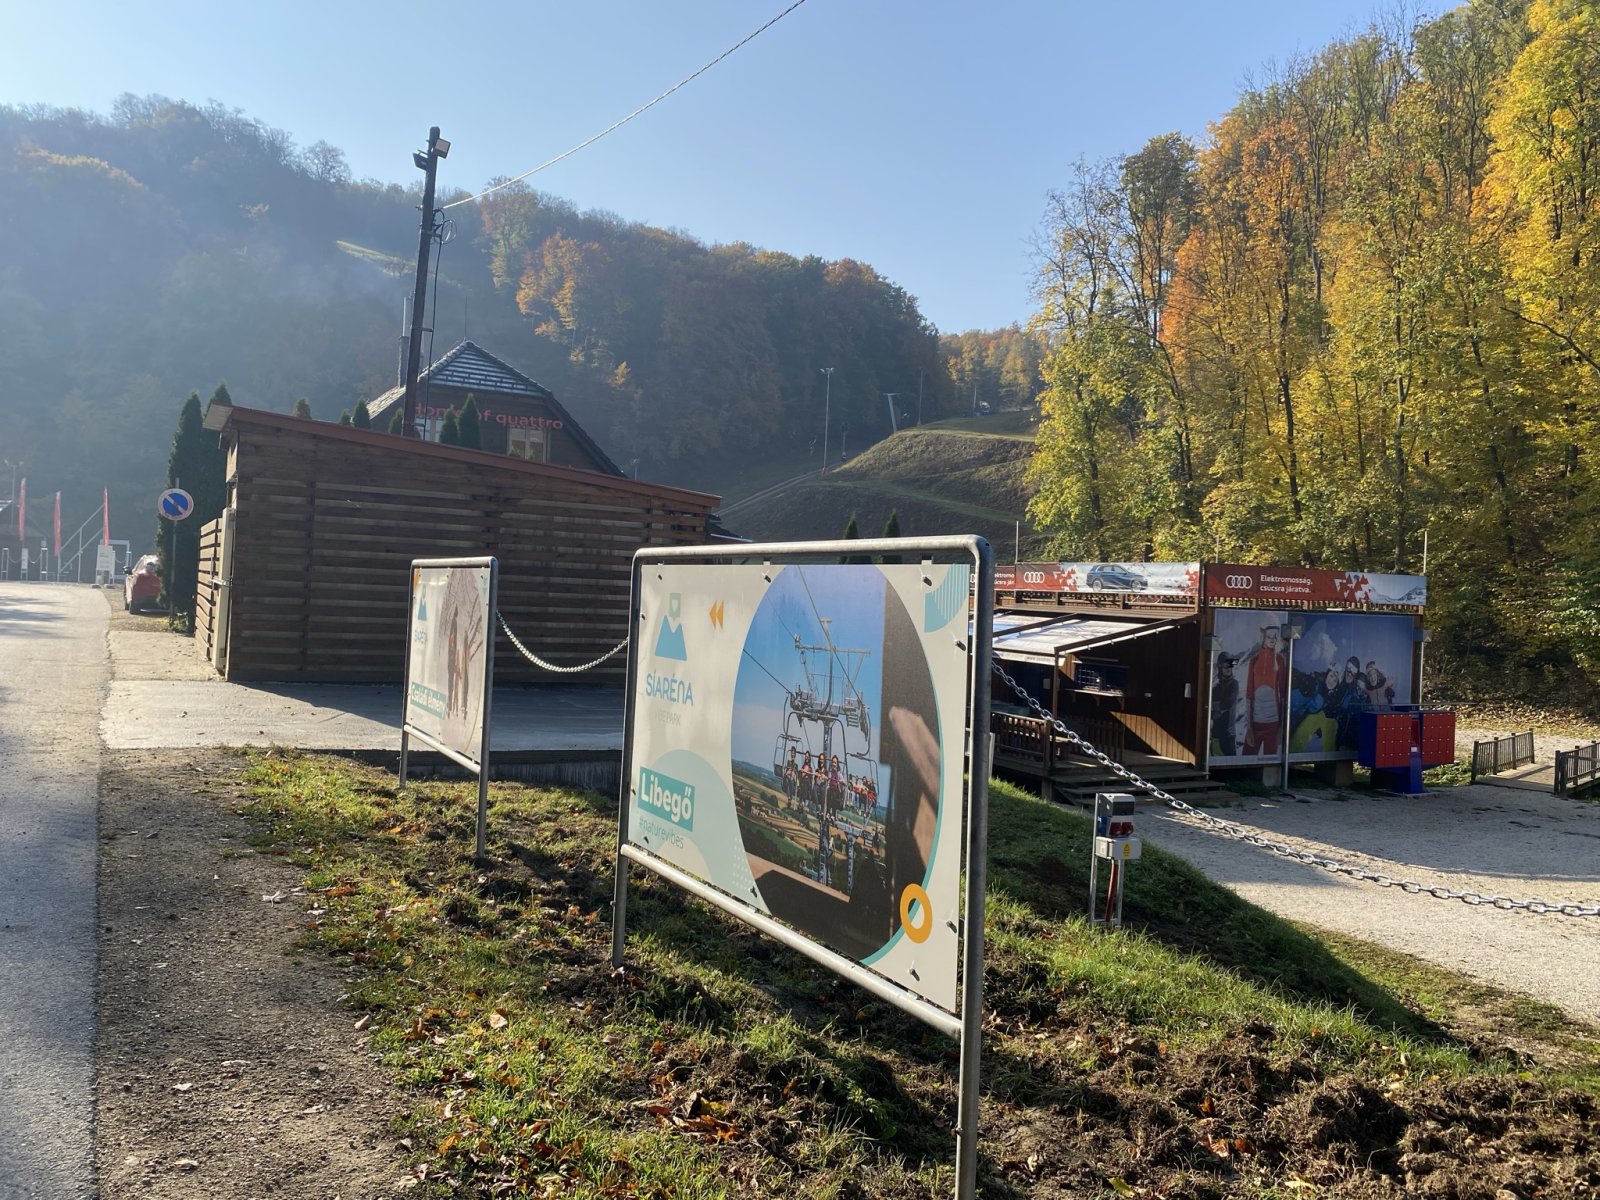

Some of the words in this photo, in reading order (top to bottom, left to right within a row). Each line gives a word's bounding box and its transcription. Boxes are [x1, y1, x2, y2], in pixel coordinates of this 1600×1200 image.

[496, 412, 564, 430] quattro
[1260, 574, 1313, 585] Elektromosság,
[1260, 584, 1285, 592] csúcsra
[1285, 585, 1311, 593] járatva.
[641, 772, 692, 823] Libegő
[639, 817, 684, 849] #naturevibes
